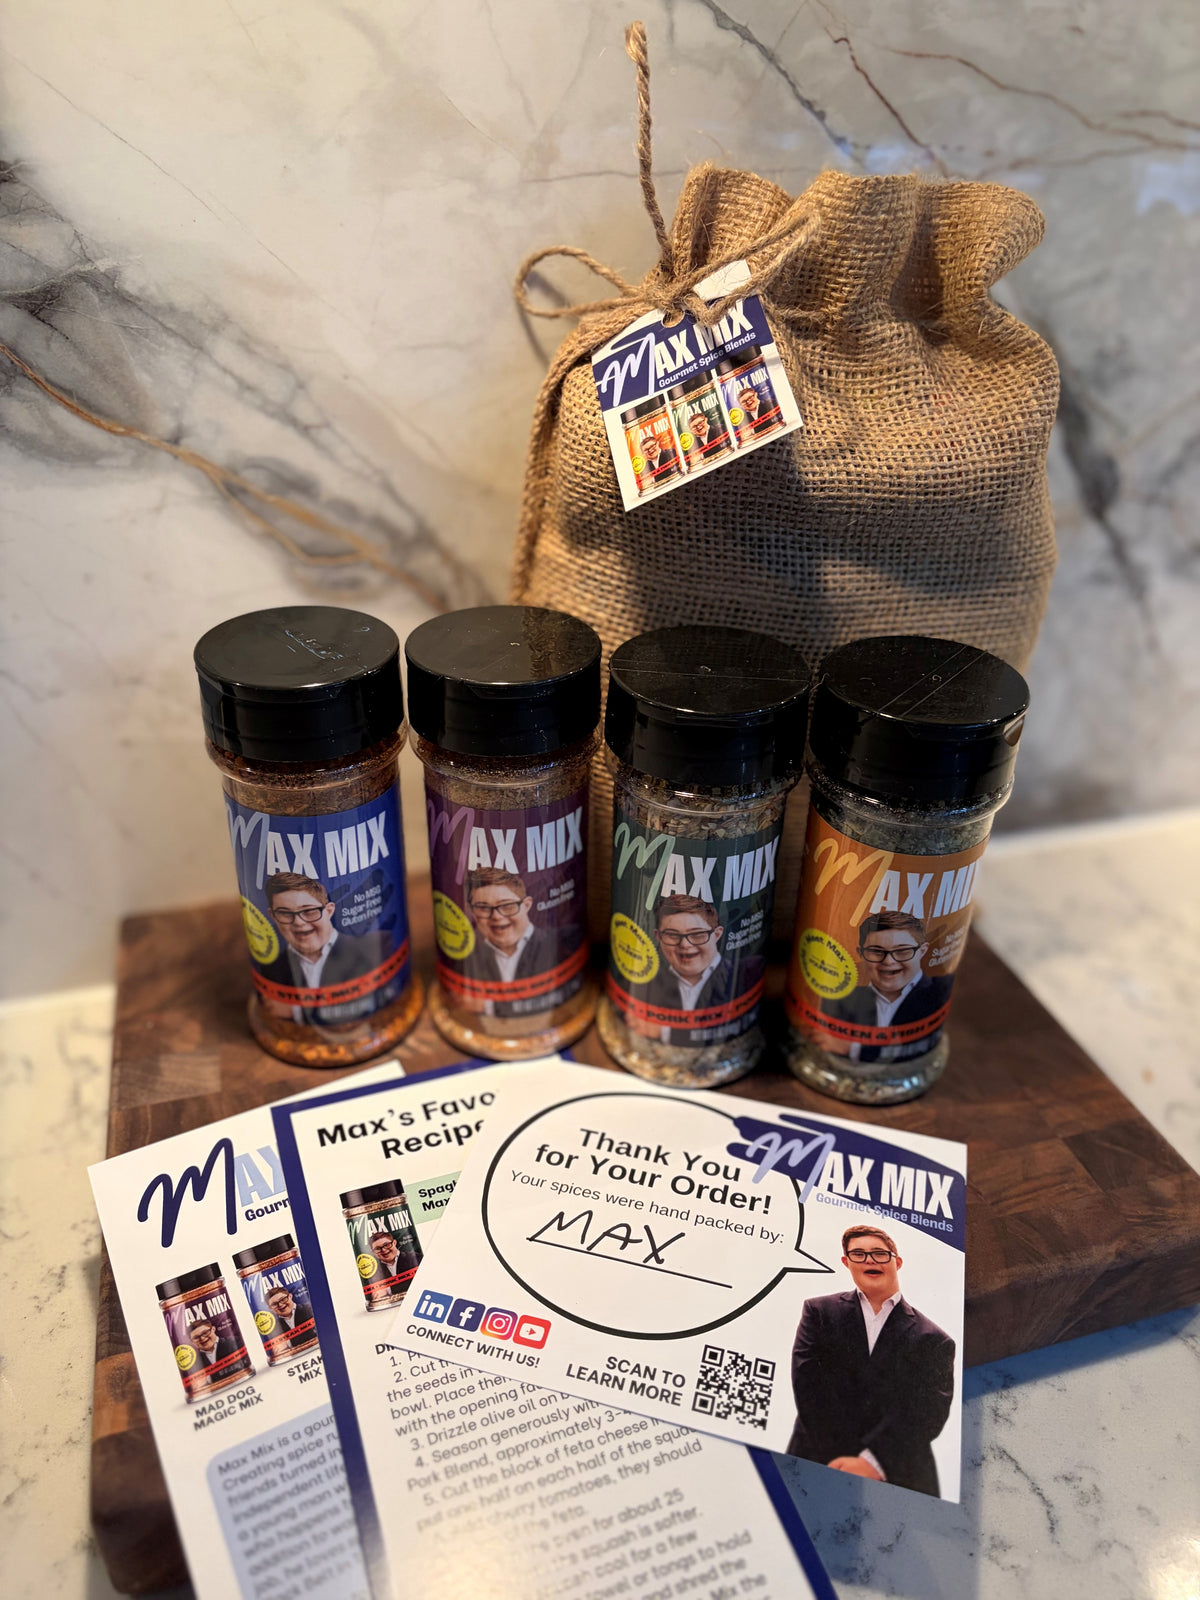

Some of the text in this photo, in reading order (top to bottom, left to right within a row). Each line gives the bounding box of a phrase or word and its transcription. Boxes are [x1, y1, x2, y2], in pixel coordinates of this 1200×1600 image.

[600, 300, 753, 407] MAX MIX
[658, 332, 756, 389] Gourmet Spice Blends
[750, 367, 769, 386] MIX
[701, 393, 720, 411] MIX
[226, 803, 390, 890] MAX MIX
[427, 800, 583, 886] MAX MIX
[614, 822, 780, 911] MAX MIX
[814, 838, 977, 927] MAX MI
[342, 902, 364, 918] Sugar
[826, 940, 847, 963] Max
[316, 1108, 416, 1148] Max's
[579, 1128, 741, 1182] Thank You
[745, 1131, 954, 1220] MAX MIX
[534, 1143, 772, 1215] for Your Order!
[387, 1209, 413, 1232] MIX
[511, 1170, 785, 1245] Your spices were hand packed by:
[816, 1192, 954, 1232] Gourmet Spice Blends
[529, 1209, 686, 1265] MAX
[282, 1262, 306, 1285] MIX
[207, 1293, 231, 1317] MIX
[390, 1356, 402, 1368] 1.
[406, 1323, 475, 1352] CONNECT
[476, 1341, 514, 1363] WITH
[515, 1352, 541, 1369] US!
[298, 1367, 323, 1385] MIX
[387, 1367, 474, 1403] the seeds in
[393, 1361, 437, 1384] 2. Cut
[565, 1363, 684, 1408] LEARN MORE
[605, 1355, 687, 1389] SCAN TO
[193, 1393, 264, 1431] MAGIC MIX
[195, 1386, 257, 1419] MAD DOG
[390, 1398, 432, 1421] bowl.
[434, 1384, 476, 1406] Place
[395, 1388, 519, 1438] with the opening
[410, 1392, 558, 1452] 3. Drizzle olive oil on
[218, 1431, 302, 1476] Max Mix is a
[407, 1470, 442, 1491] Pork
[496, 1416, 602, 1462] approximately
[414, 1404, 571, 1469] 4. Season generously
[617, 1459, 650, 1480] they
[653, 1438, 703, 1468] should
[222, 1438, 325, 1491] Creating spice
[441, 1481, 470, 1500] Cut
[472, 1472, 499, 1489] the
[500, 1456, 543, 1480] block
[545, 1447, 560, 1464] of
[561, 1438, 595, 1458] feta
[597, 1419, 649, 1445] cheese
[536, 1465, 576, 1488] each
[576, 1453, 608, 1474] half
[609, 1445, 625, 1462] of
[627, 1437, 652, 1456] the
[664, 1487, 685, 1505] 25
